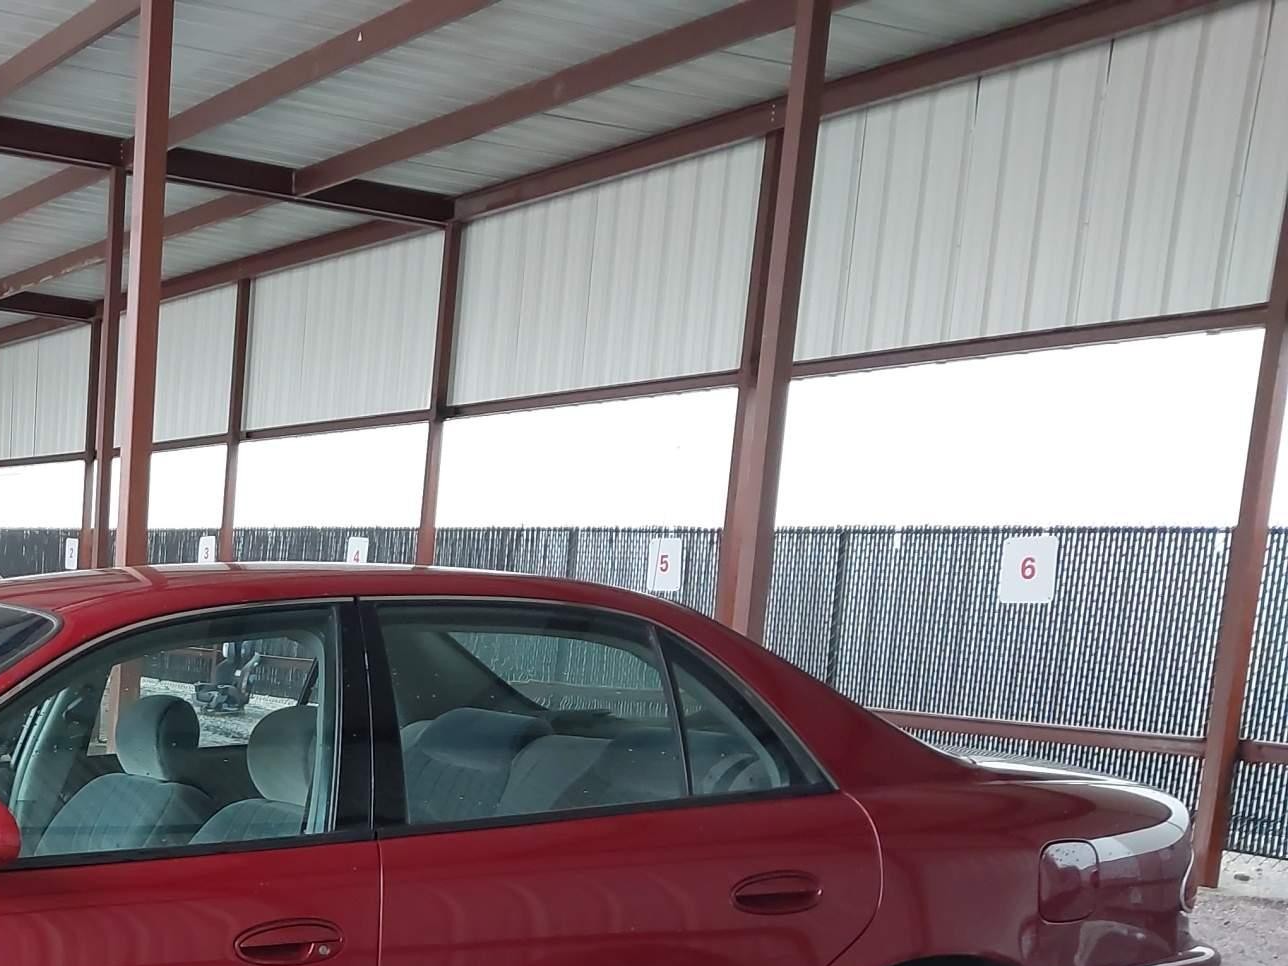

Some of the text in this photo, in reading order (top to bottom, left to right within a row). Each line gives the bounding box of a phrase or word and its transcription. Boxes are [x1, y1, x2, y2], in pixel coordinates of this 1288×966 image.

[353, 549, 360, 563] 4
[660, 554, 669, 572] 5
[1021, 556, 1036, 580] 6
